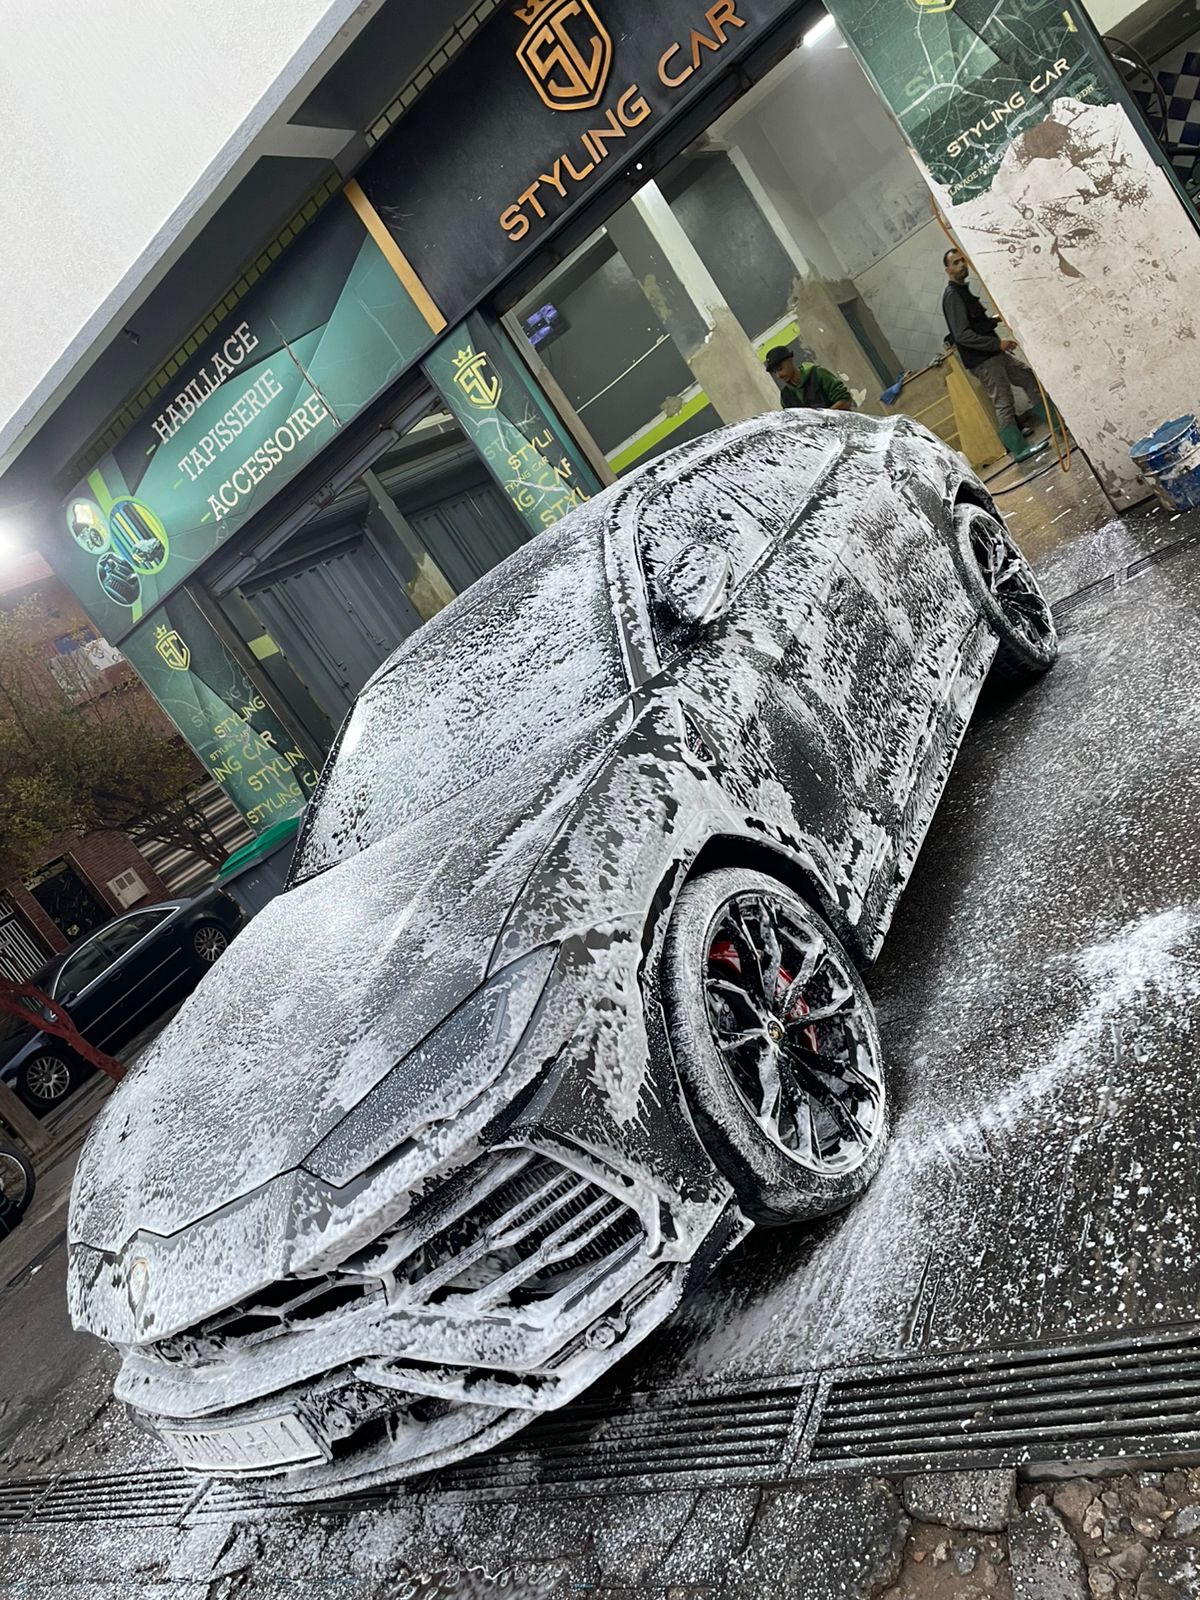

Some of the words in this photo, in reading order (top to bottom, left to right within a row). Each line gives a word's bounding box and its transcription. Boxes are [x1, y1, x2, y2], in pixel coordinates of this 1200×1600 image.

[500, 84, 652, 242] STYLING
[657, 0, 747, 88] CAR
[947, 92, 1026, 158] STYLING
[1030, 57, 1070, 94] CAR
[950, 170, 979, 196] LAVAGE
[152, 321, 259, 444] HABILLAGE
[177, 367, 283, 481] TAPISSERIE
[208, 393, 328, 521] ACCESSOIRE
[531, 456, 549, 472] CAR
[214, 696, 266, 738] STYLING
[209, 739, 238, 761] STYLING
[242, 730, 277, 760] CAR
[246, 782, 301, 824] STYLING
